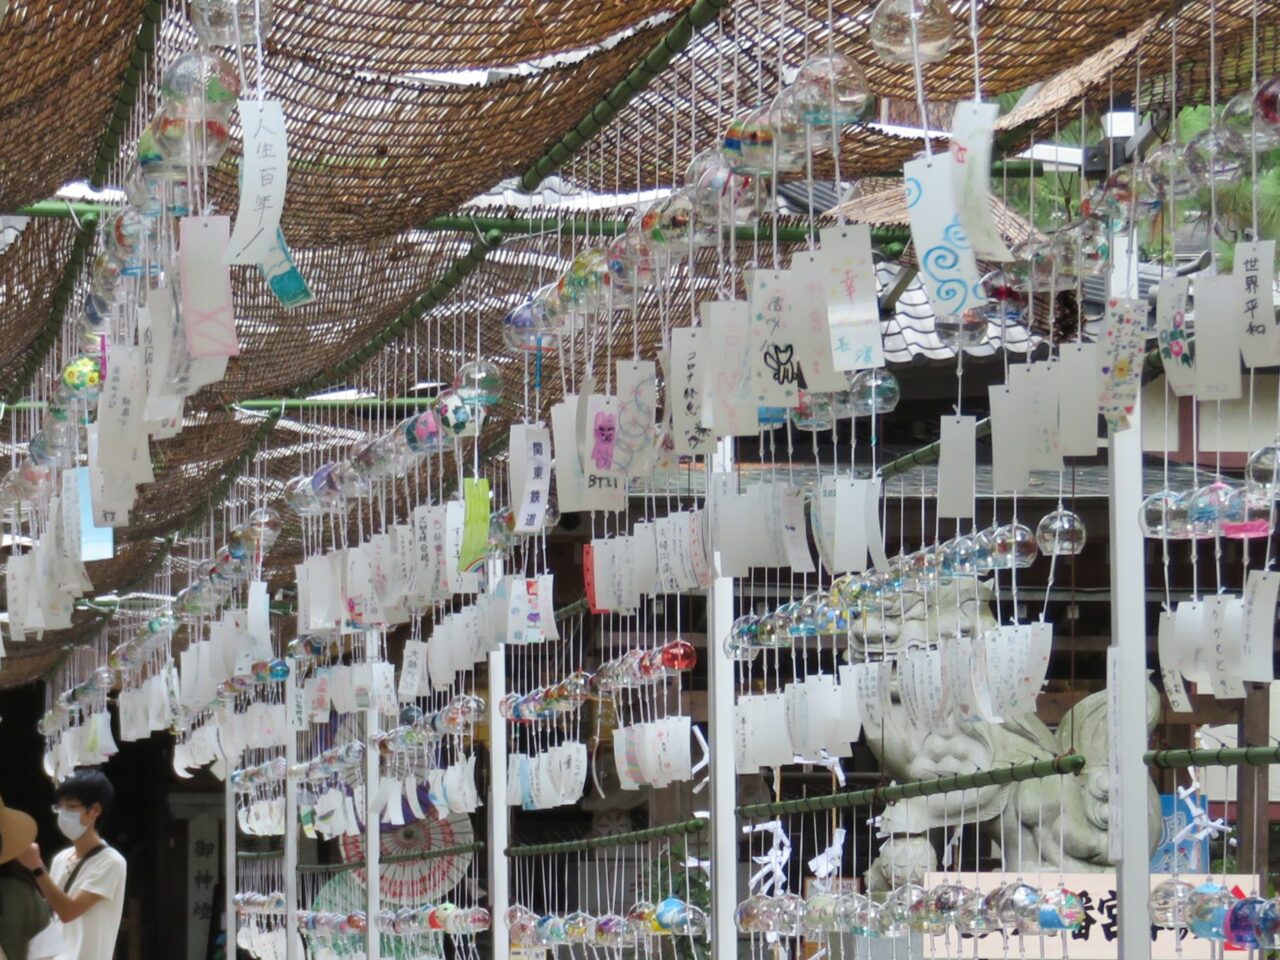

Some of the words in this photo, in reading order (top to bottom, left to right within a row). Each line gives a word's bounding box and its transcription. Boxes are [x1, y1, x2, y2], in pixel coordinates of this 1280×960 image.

[1243, 257, 1266, 336] 世界平和
[524, 441, 544, 528] 関東鉄道
